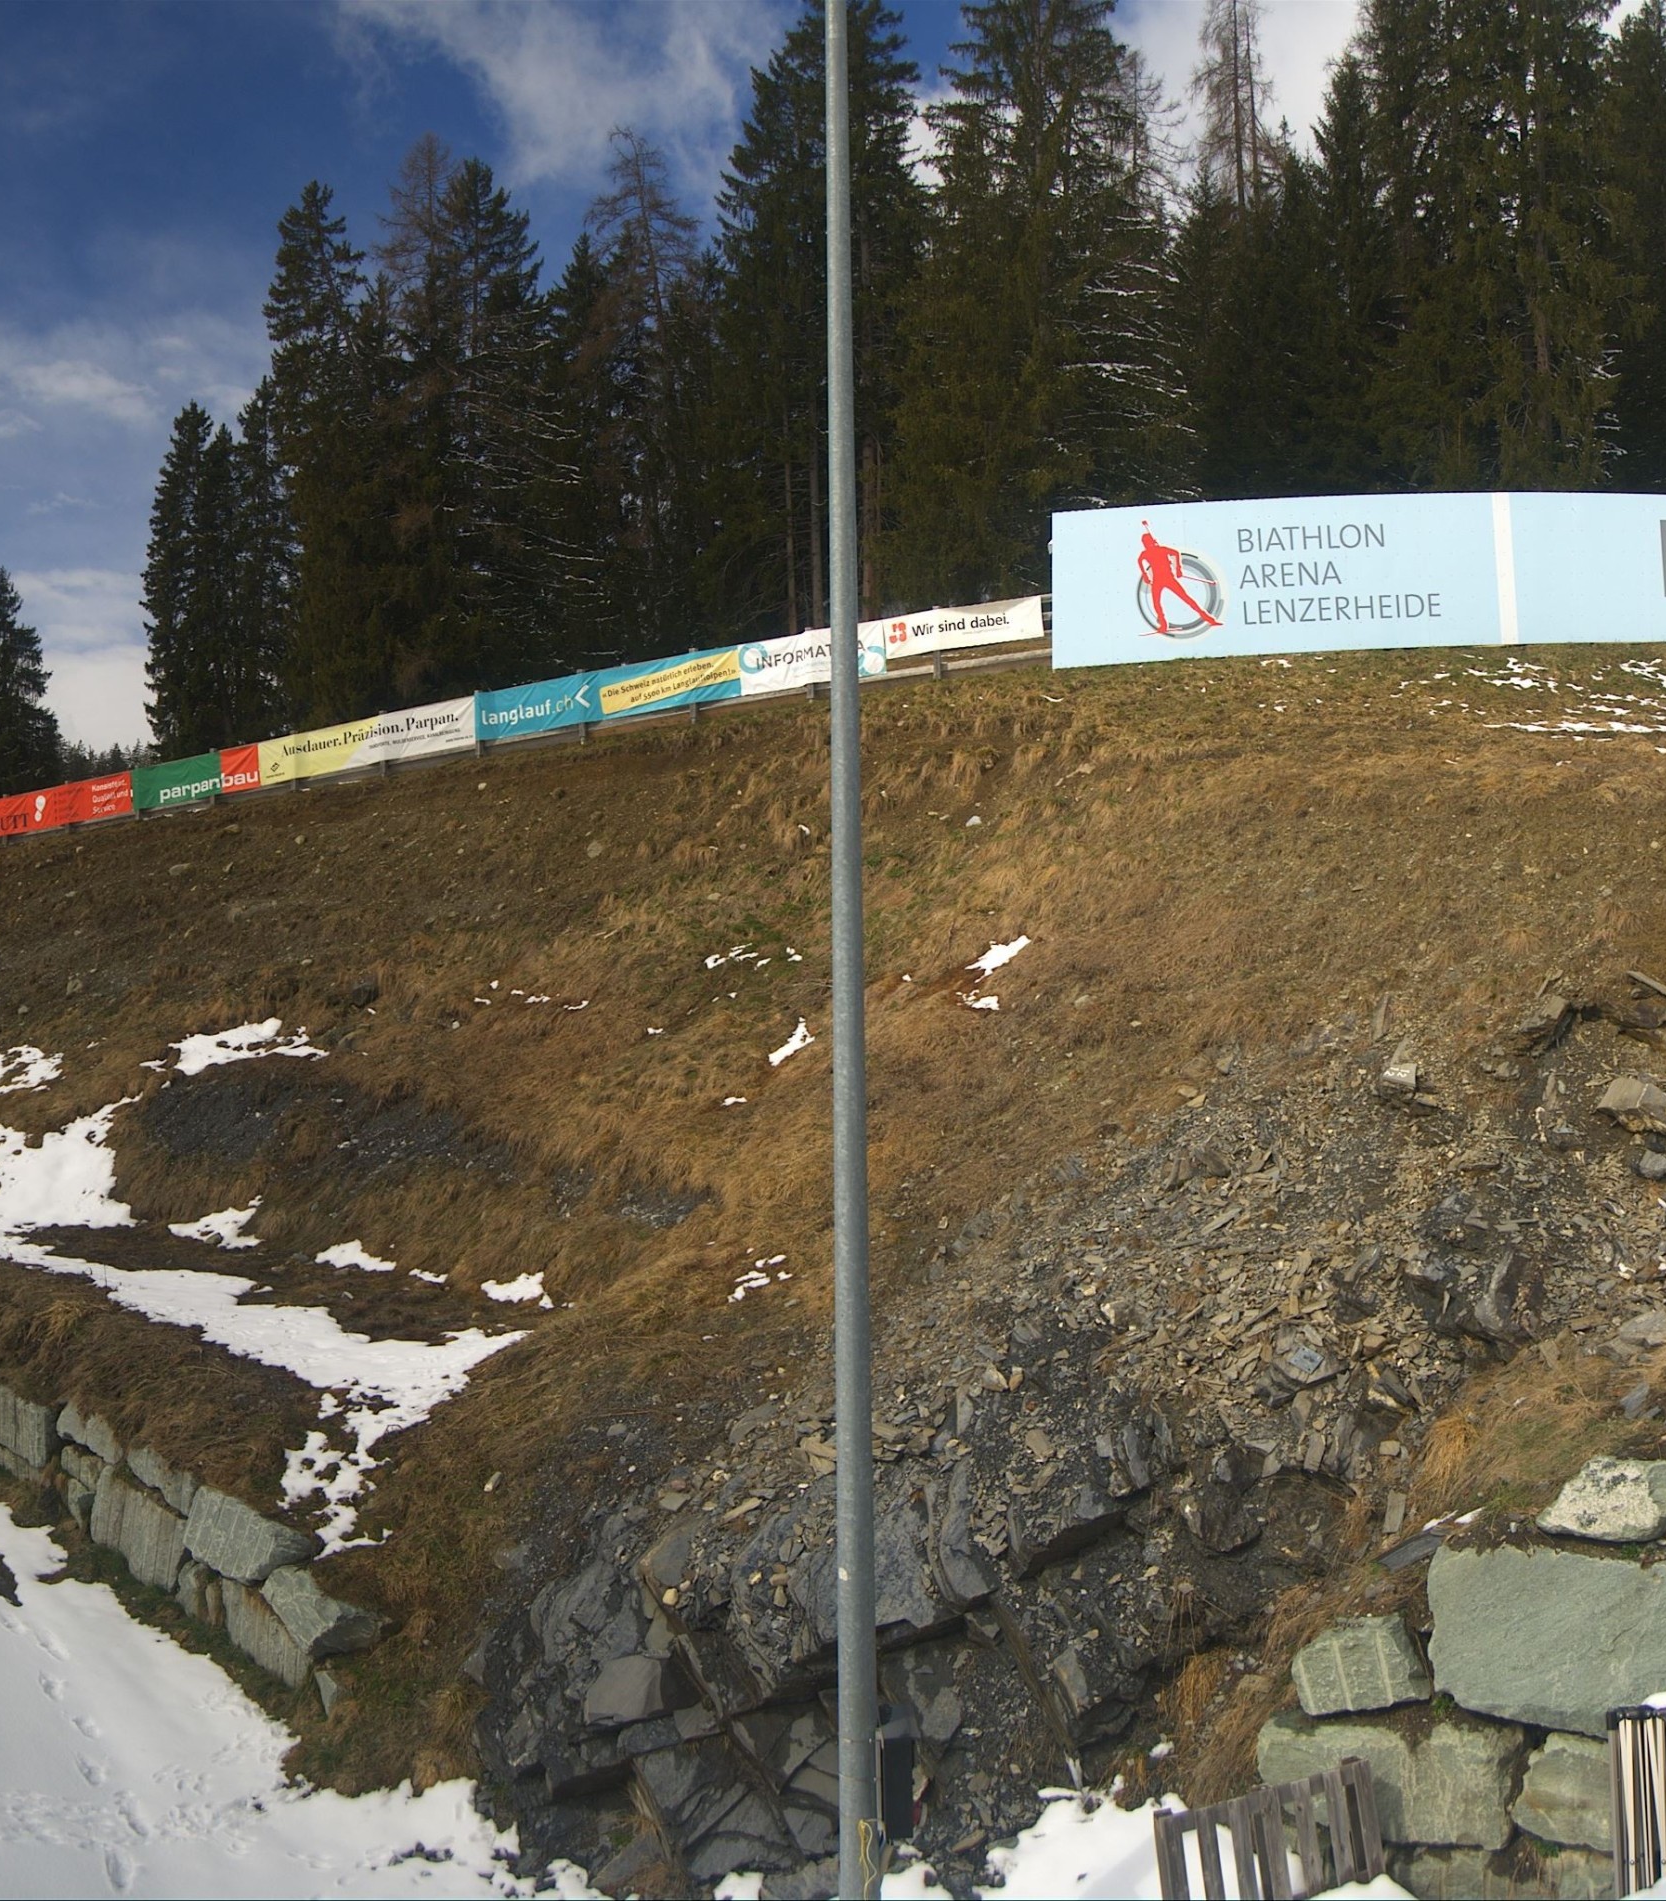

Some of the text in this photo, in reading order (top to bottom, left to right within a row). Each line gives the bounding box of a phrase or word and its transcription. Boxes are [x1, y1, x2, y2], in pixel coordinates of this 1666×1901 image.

[1237, 523, 1385, 553] BIATHLON
[1239, 561, 1342, 589] ARENA
[912, 623, 933, 636] Wir
[938, 618, 965, 632] sind
[970, 613, 1010, 629] dabei.
[1243, 593, 1442, 625] LENZERHEIDE
[756, 639, 866, 670] INFORMATA
[620, 680, 650, 694] Schweiz
[683, 662, 714, 675] erleben.
[481, 694, 574, 725] langlauf.ch
[631, 694, 642, 703] auf
[643, 689, 660, 701] 5500
[661, 685, 671, 694] km
[282, 713, 459, 757] Ausdauer. Präzision. Parpan.
[159, 770, 259, 803] parpanbau
